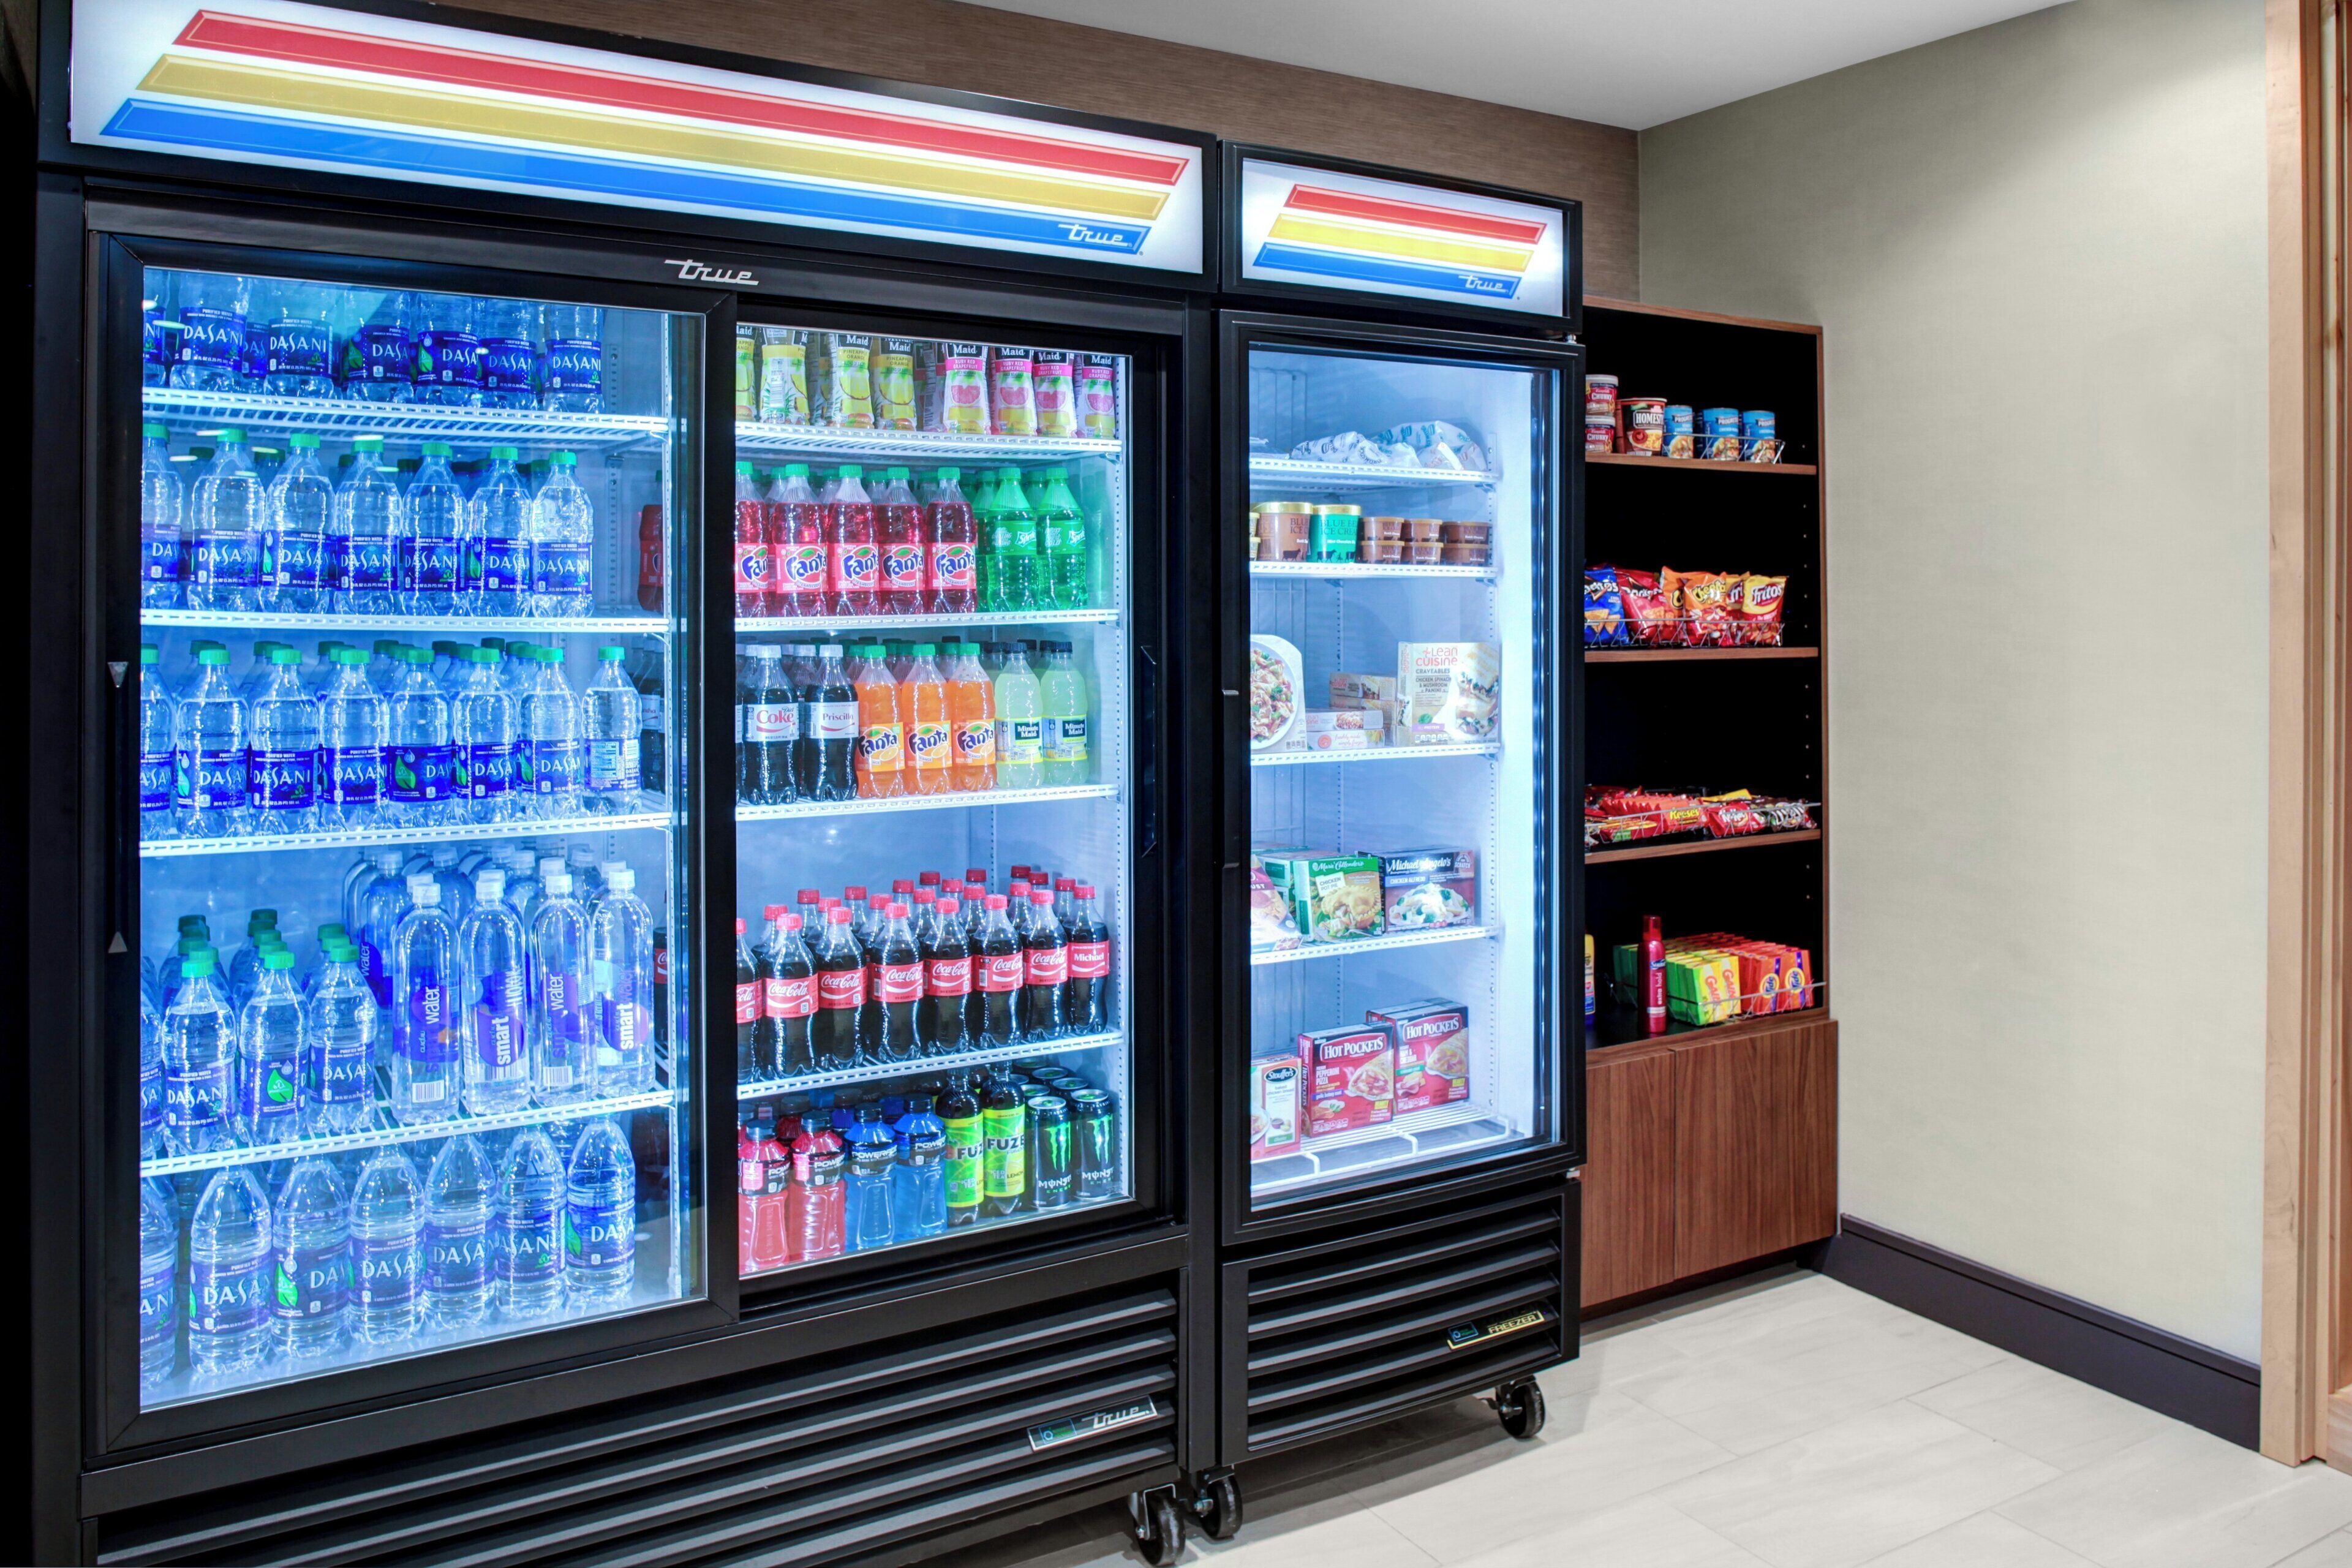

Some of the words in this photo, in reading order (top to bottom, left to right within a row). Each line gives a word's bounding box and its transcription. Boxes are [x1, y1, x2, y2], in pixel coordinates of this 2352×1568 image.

[664, 258, 759, 286] true
[184, 323, 243, 346] DASANI
[270, 333, 326, 352] DASANI
[846, 335, 869, 345] Maid
[372, 342, 408, 360] DASA
[889, 342, 911, 352] Maid
[954, 344, 977, 354] Maid
[1001, 347, 1025, 356] Maid
[1038, 352, 1061, 361] Maid
[553, 353, 601, 371] DASANI
[1091, 355, 1112, 365] Maid
[1635, 412, 1664, 424] HOMEST
[198, 545, 257, 566] DASANI
[341, 550, 395, 570] DASANI
[405, 551, 458, 571] DASANI
[842, 552, 879, 579] Fanta
[882, 552, 924, 579] Fanta
[935, 549, 975, 576] Fanta
[538, 556, 589, 576] DASANI
[741, 554, 768, 579] Fan
[785, 552, 827, 581] Fanta
[1752, 584, 1782, 605] Fritos
[1431, 647, 1458, 656] Lean
[756, 710, 794, 724] Coke
[823, 713, 854, 722] Priscilla
[858, 733, 898, 758] Fanta
[908, 729, 948, 755] Fanta
[957, 728, 994, 753] Fanta
[254, 767, 310, 788] DASANI
[334, 763, 387, 783] DASANI
[1388, 859, 1420, 872] Michael
[1319, 878, 1341, 886] CHICKEN
[1074, 953, 1104, 962] Michael
[1765, 976, 1774, 993] Tide
[1790, 970, 1799, 988] Tide
[547, 973, 564, 1011] water
[425, 986, 440, 1025] water
[616, 1002, 634, 1050] smart
[1406, 1026, 1423, 1039] HOT
[1423, 1017, 1459, 1035] POCKETS
[492, 1016, 511, 1066] smart
[1324, 1045, 1343, 1060] HOT
[1344, 1037, 1384, 1056] POCKETS
[1268, 1068, 1294, 1081] Stouffer's
[1316, 1077, 1329, 1085] PIZZA
[957, 1142, 983, 1160] FUZ
[987, 1134, 1025, 1150] FUZE
[1007, 1170, 1023, 1179] LEMON
[1488, 1314, 1536, 1335] FREEZER
